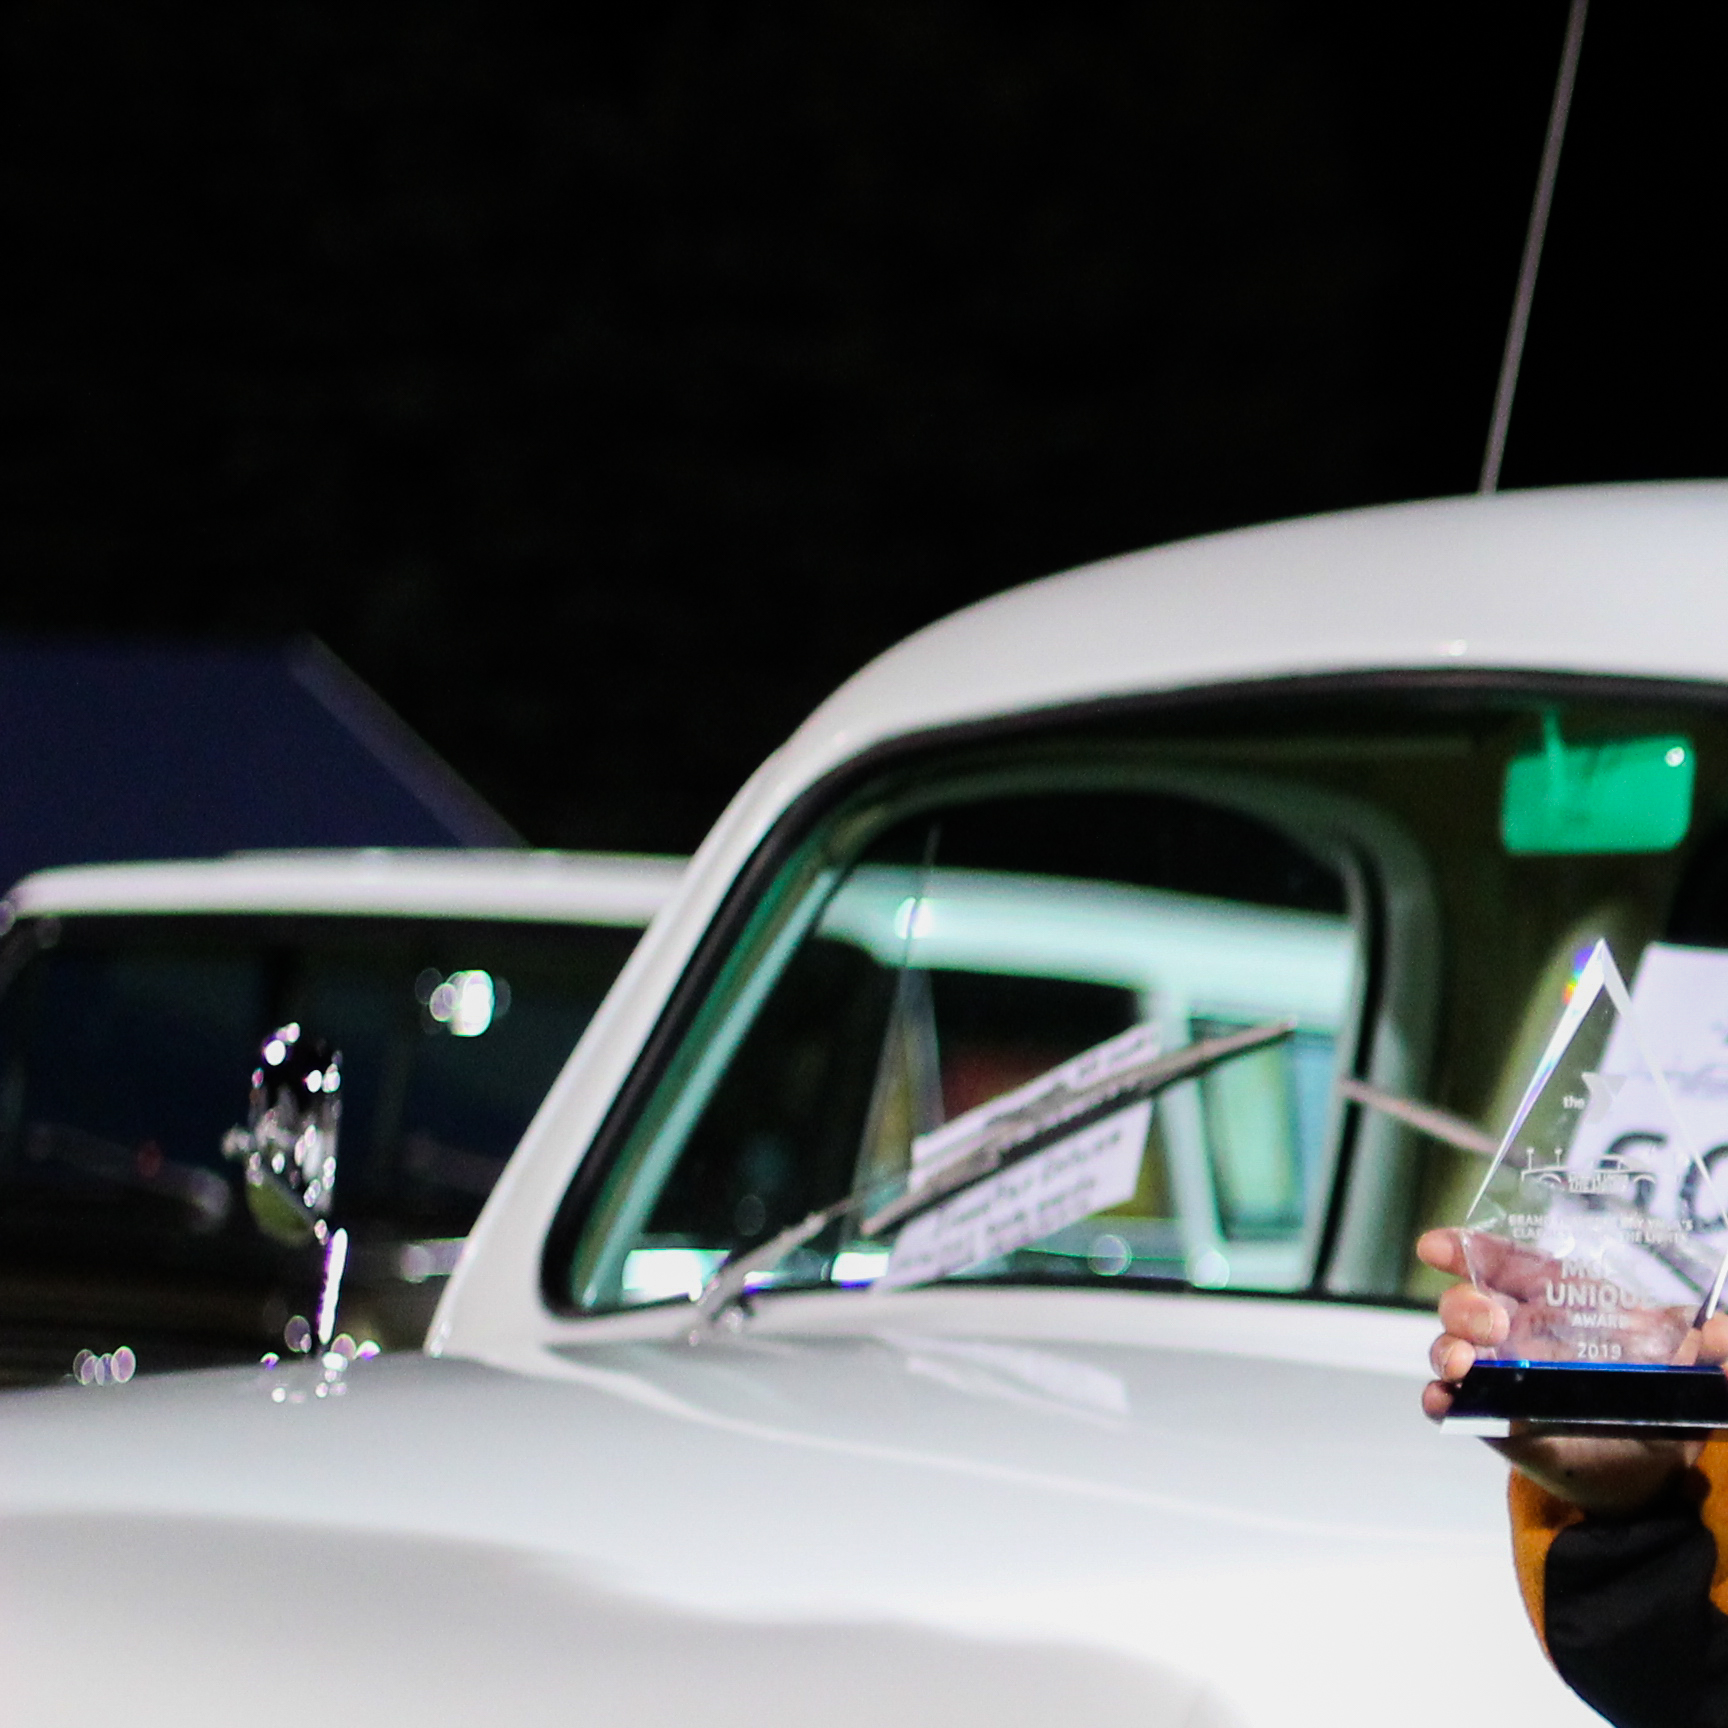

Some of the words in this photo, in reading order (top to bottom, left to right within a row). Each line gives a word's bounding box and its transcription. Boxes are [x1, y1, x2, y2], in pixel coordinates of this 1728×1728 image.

[1562, 1095, 1586, 1109] the
[1571, 1313, 1630, 1330] AWARD
[1577, 1341, 1622, 1361] 2019
